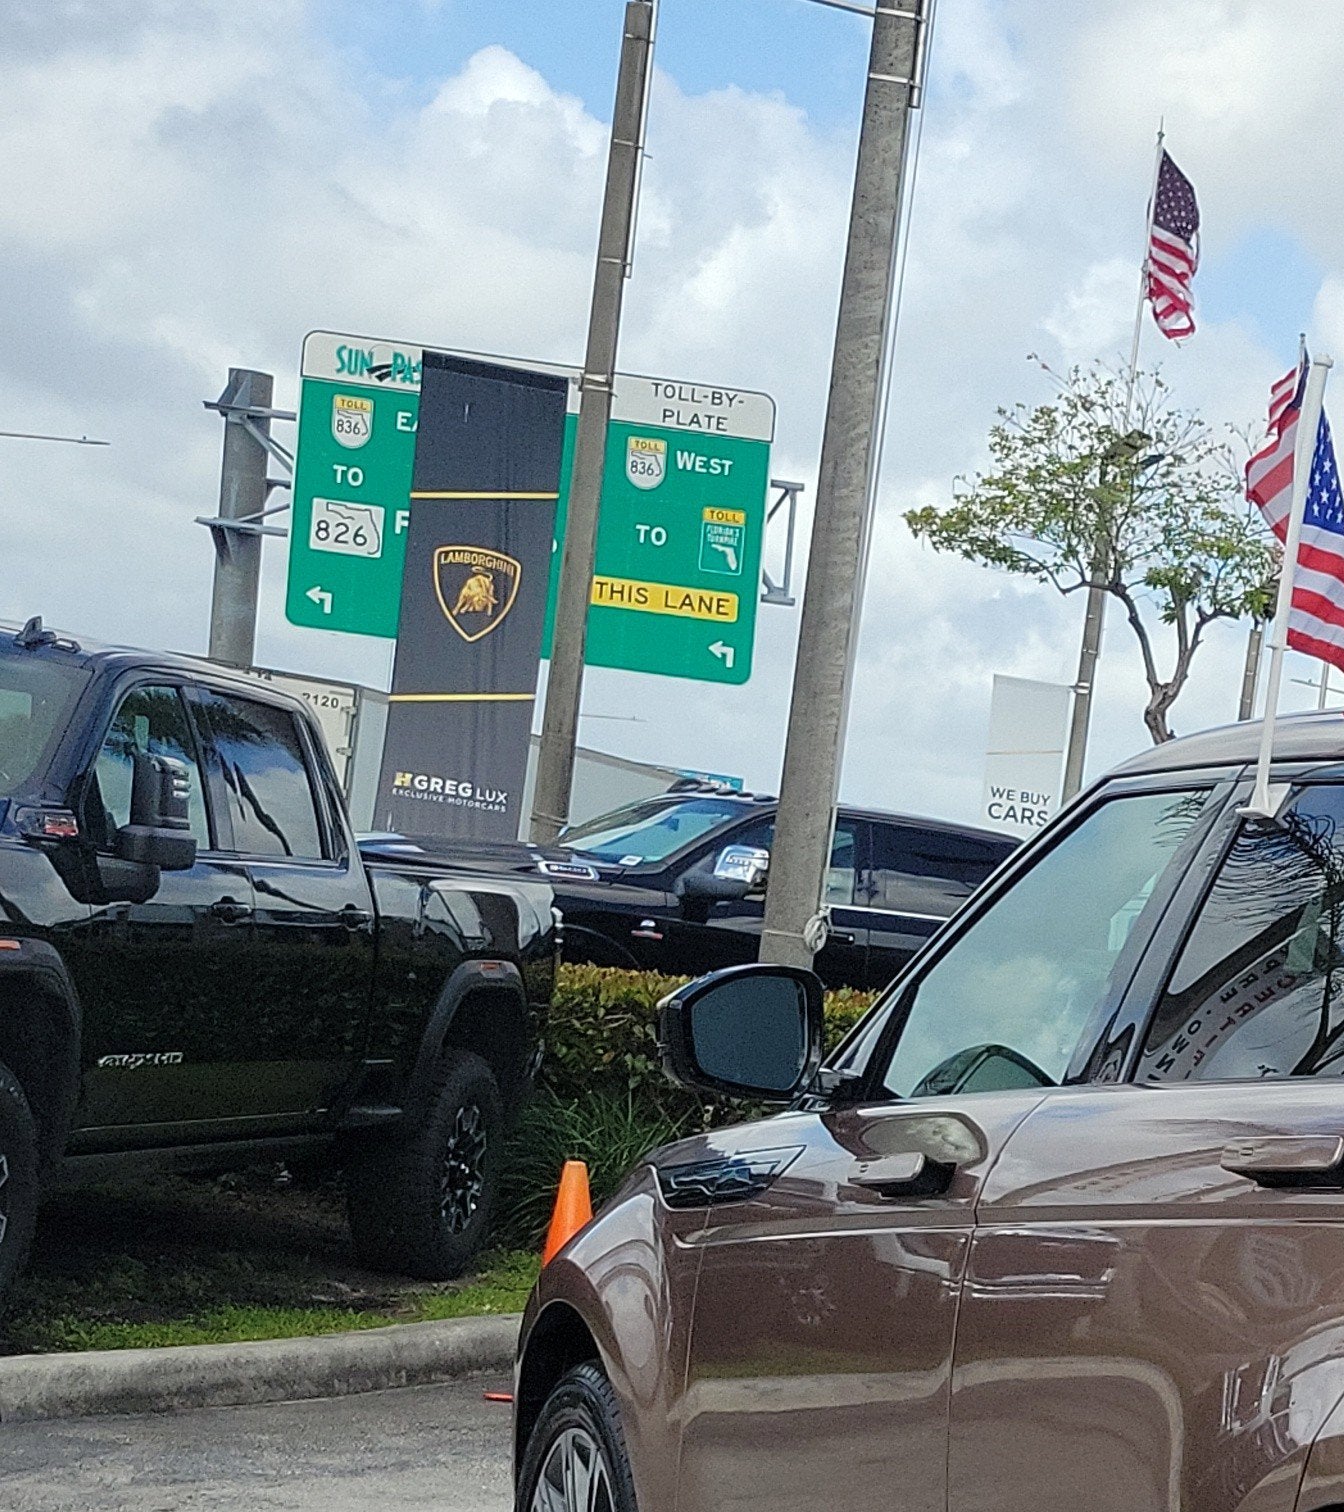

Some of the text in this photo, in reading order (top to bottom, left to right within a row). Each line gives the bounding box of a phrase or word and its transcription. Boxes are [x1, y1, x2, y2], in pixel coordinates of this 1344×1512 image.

[335, 345, 374, 378] SUN
[340, 399, 367, 411] TOLL
[651, 382, 745, 408] TOLL-BY-
[336, 419, 361, 435] 836
[662, 408, 728, 432] PLATE
[634, 440, 661, 451] TOLL
[333, 464, 364, 487] TO
[630, 460, 655, 477] 836
[709, 510, 740, 524] TOLL
[315, 519, 368, 547] 826
[635, 524, 667, 547] TO
[595, 581, 730, 616] THIS LANE
[392, 788, 507, 813] EXCLUSIVE MOTORCARS
[475, 787, 508, 804] LUX
[990, 786, 1051, 806] WE BUY
[988, 802, 1049, 827] CARS
